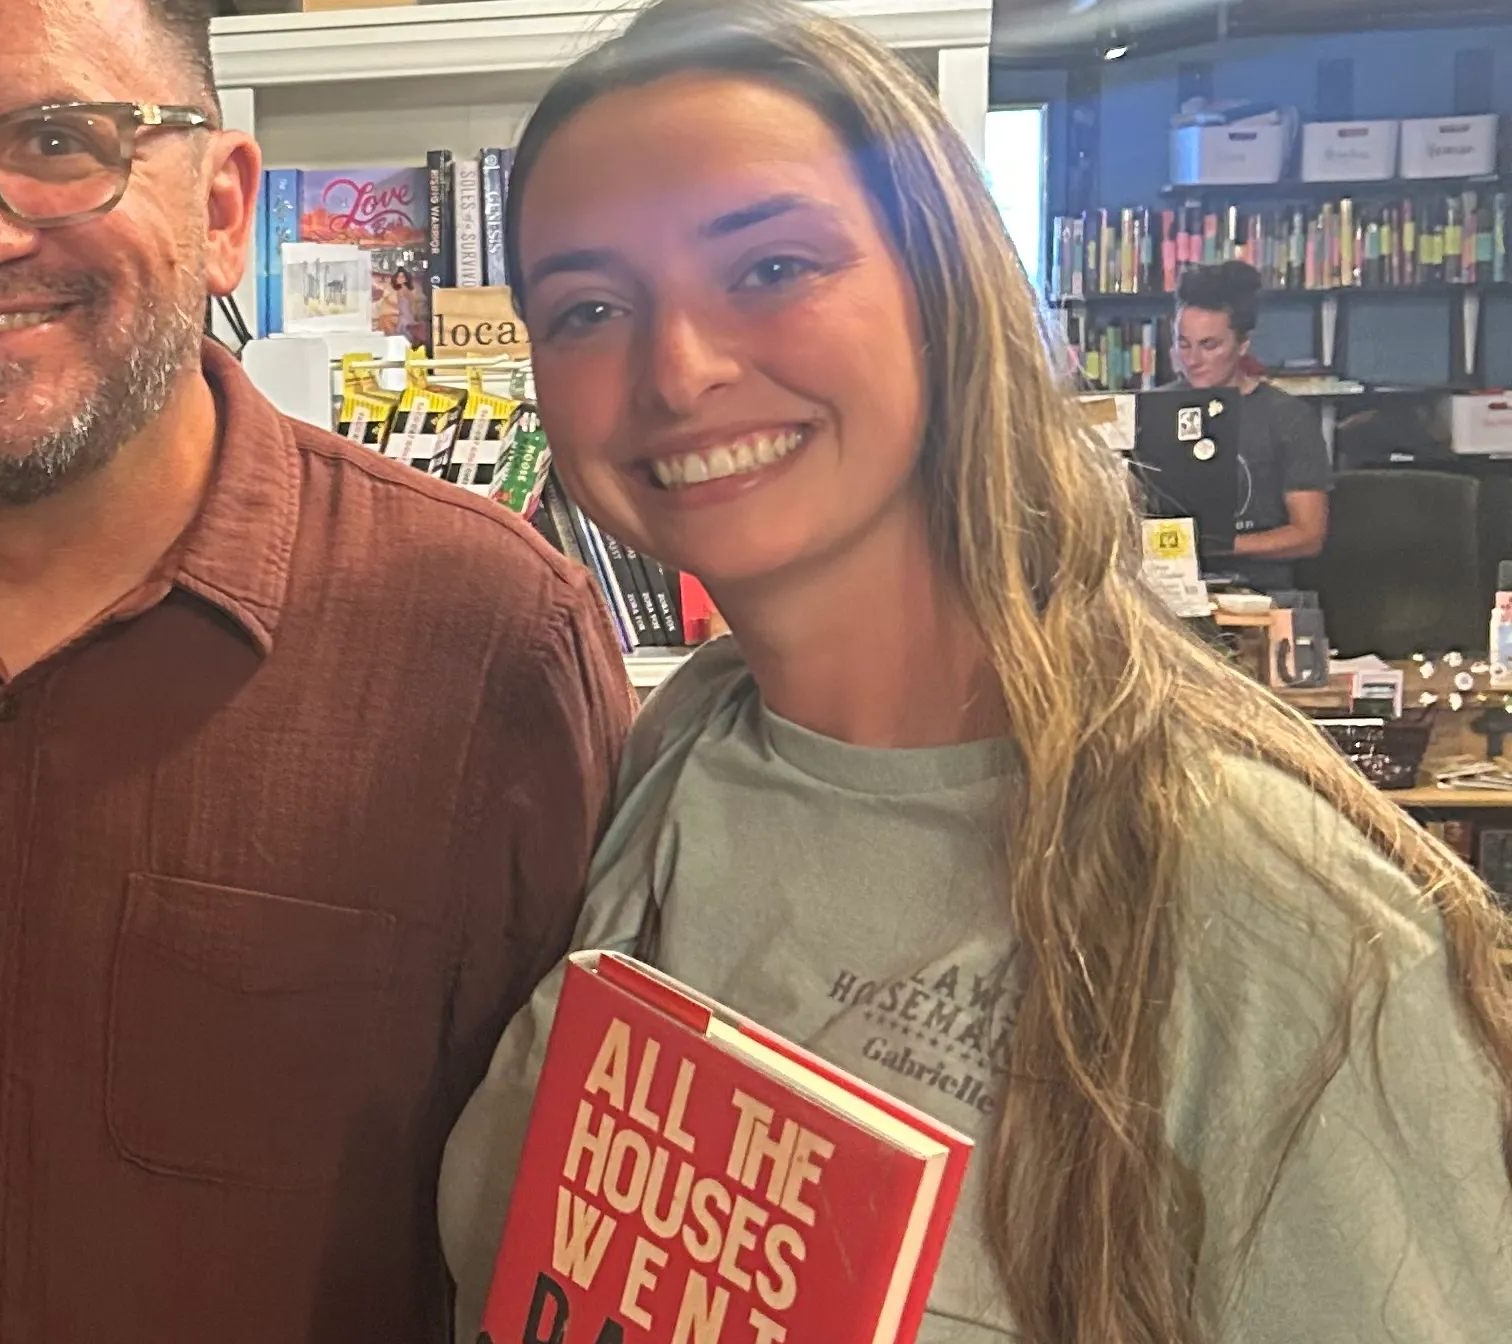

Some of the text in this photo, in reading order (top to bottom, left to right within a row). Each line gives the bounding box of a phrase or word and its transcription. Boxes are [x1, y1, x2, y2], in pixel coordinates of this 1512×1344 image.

[322, 177, 415, 232] Love
[460, 170, 476, 210] SOLES
[485, 190, 504, 254] GENESIS
[460, 233, 478, 287] SURVIVO
[433, 314, 531, 347] loca
[517, 444, 536, 482] MOOSE
[862, 1036, 994, 1114] Gabrielle
[584, 1018, 835, 1227] ALL THE
[563, 1099, 806, 1311] HOUSES
